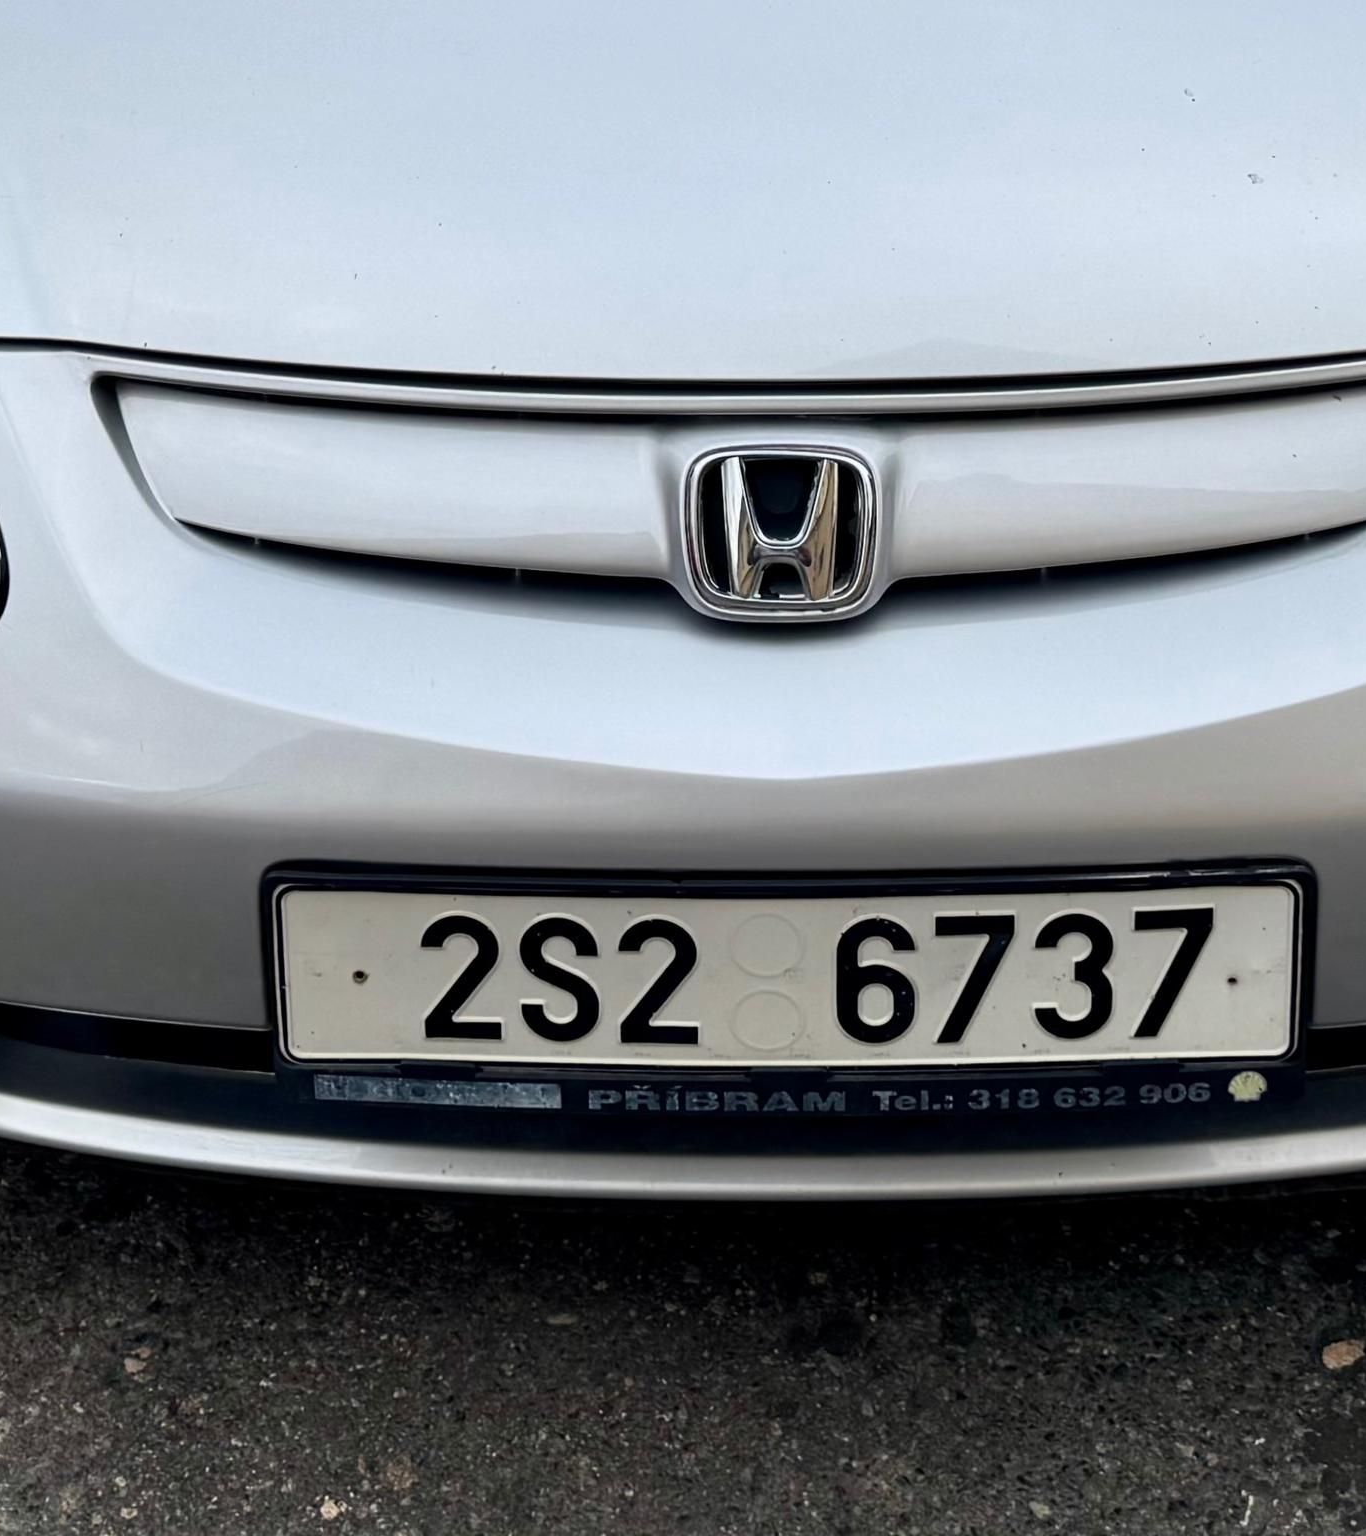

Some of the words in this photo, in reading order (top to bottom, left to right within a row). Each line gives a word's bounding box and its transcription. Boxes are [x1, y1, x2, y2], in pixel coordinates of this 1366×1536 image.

[420, 912, 699, 1046] 2S2
[836, 907, 1215, 1045] 6737
[872, 1089, 954, 1112] Tel.:
[968, 1088, 1040, 1110] 318
[1053, 1086, 1127, 1108] 632
[1139, 1082, 1211, 1105] 906
